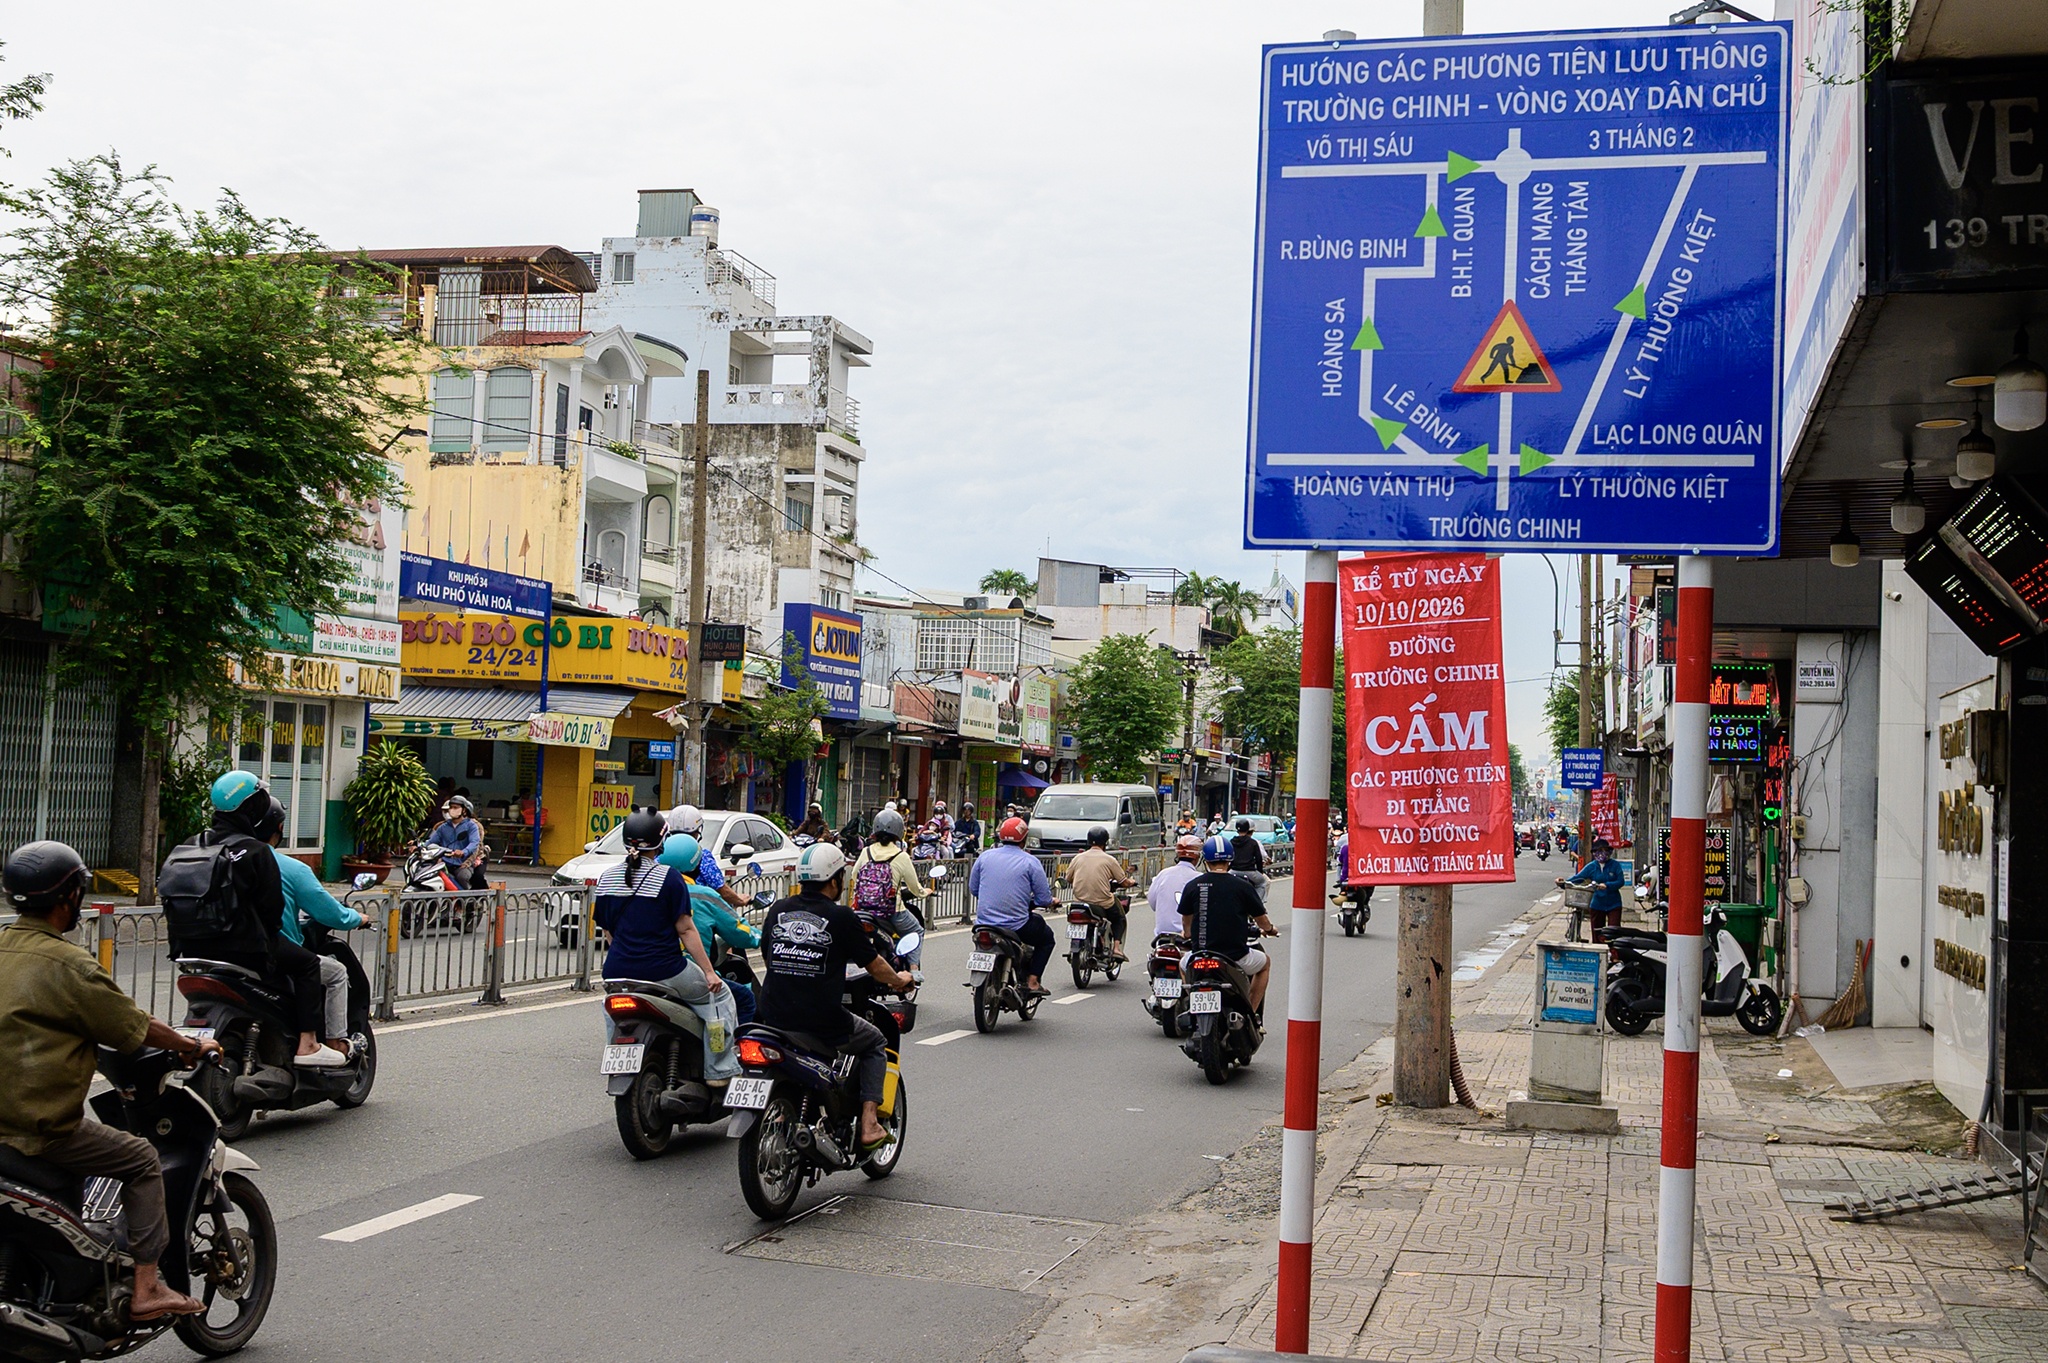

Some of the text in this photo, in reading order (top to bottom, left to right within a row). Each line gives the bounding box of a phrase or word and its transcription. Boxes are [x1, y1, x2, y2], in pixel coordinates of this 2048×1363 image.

[1282, 40, 1767, 87] HƯỚNG CÁC PHƯƠNG TIỆN LƯU THÔNG
[1283, 93, 1384, 123] TRƯỜNG
[1392, 94, 1469, 119] CHINH
[1497, 85, 1567, 115] VÒNG
[1574, 87, 1640, 113] XOAY
[1648, 80, 1703, 110] DÂN
[1712, 74, 1767, 107] CHỦ
[1306, 131, 1413, 162] VÕ THỊ SÁU
[1589, 122, 1694, 150] 3 THÁNG 2
[1281, 234, 1407, 260] R.BÙNG BINH
[1451, 187, 1475, 297] B.H.T. QUAN
[1524, 182, 1558, 299] CÁCH MẠNG
[1560, 180, 1589, 297] THÁNG TÁM
[1923, 217, 1989, 249] 139
[1623, 208, 1717, 399] LÝ THƯỜNG KIỆT
[1317, 297, 1346, 397] HOÀNG SA
[1382, 383, 1462, 450] LÊ BÌNH
[1593, 419, 1763, 450] LẠC LONG QUÂN
[1294, 470, 1455, 501] HOÀNG VĂN THỤ
[1559, 471, 1729, 503] LÝ THƯỜNG KIỆT
[1428, 512, 1581, 539] TRƯỜNG CHINH
[448, 570, 488, 588] KHU PHỐ 34
[1352, 562, 1486, 592] KỂ TỪ NGÀY
[417, 581, 441, 598] KHU
[443, 585, 466, 603] PHỐ
[468, 590, 489, 607] VĂN
[491, 592, 513, 611] HOÁ
[1356, 596, 1465, 625] 10/10/2026
[401, 612, 613, 649] BÚN BÒ CÔ BI
[628, 623, 670, 657] BÚN
[705, 628, 740, 640] HOTEL
[824, 625, 859, 657] JOTUN
[467, 647, 538, 668] 24/24
[1389, 634, 1456, 657] ĐƯỜNG
[1351, 663, 1500, 689] TRƯỜNG CHINH
[564, 716, 579, 743] CÔ
[580, 723, 593, 745] BI
[1365, 692, 1490, 756] CẤM
[1725, 724, 1754, 736] GÓP
[1722, 738, 1758, 750] HÀNG
[1351, 762, 1506, 788] CÁC PHƯƠNG TIỆN
[593, 786, 629, 809] BÚN BÒ
[1386, 788, 1471, 816] ĐI THẲNG
[591, 809, 610, 832] CÔ
[1378, 824, 1480, 845] VÀO ĐƯỜNG
[1358, 849, 1504, 876] CÁCH MẠNG THÁNG TÁM
[772, 942, 824, 959] Budweiser
[1191, 1003, 1219, 1012] 330.74
[1194, 993, 1216, 1003] 59-U2
[604, 1058, 638, 1072] 049.04
[609, 1047, 638, 1059] 50-AC
[734, 1079, 766, 1093] 60-AC
[726, 1093, 766, 1108] 605.18
